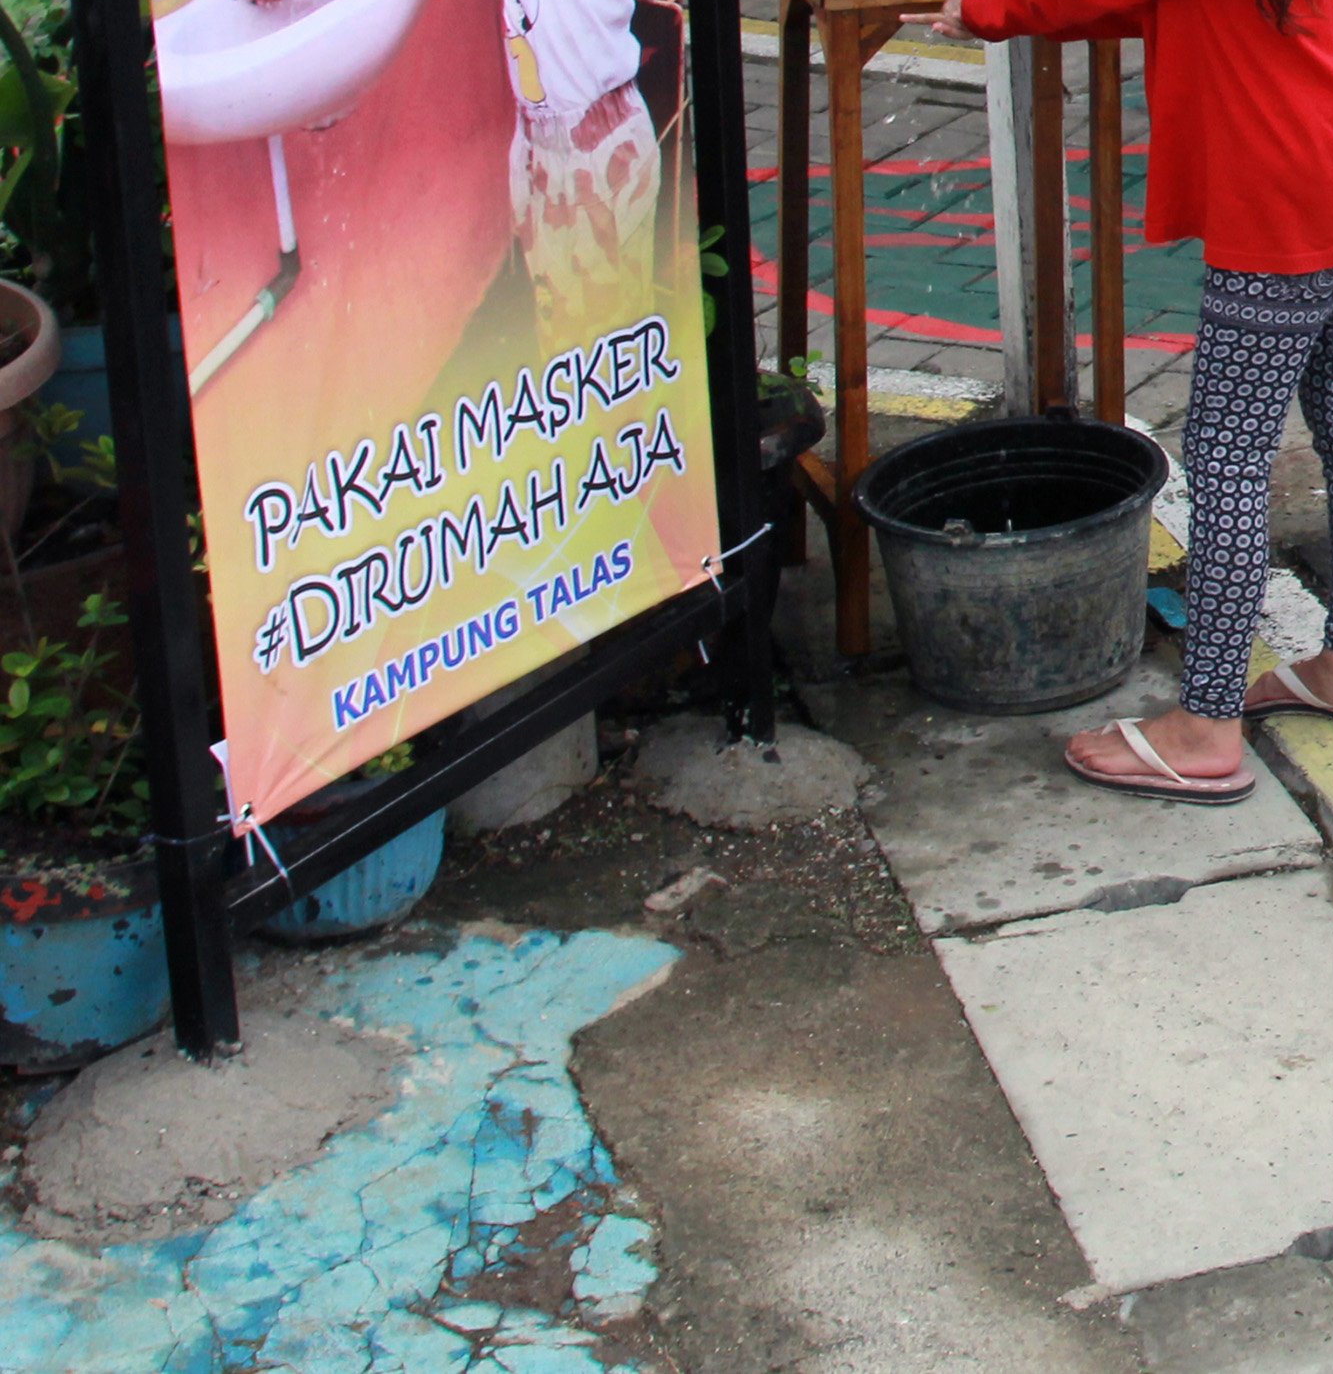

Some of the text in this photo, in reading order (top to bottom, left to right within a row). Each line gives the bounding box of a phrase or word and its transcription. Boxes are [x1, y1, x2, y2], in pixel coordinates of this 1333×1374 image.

[244, 315, 680, 572] PAKAI MASKER
[254, 409, 687, 673] #DIRUMAH AJA
[332, 542, 633, 730] KAMPUNG TALAS
